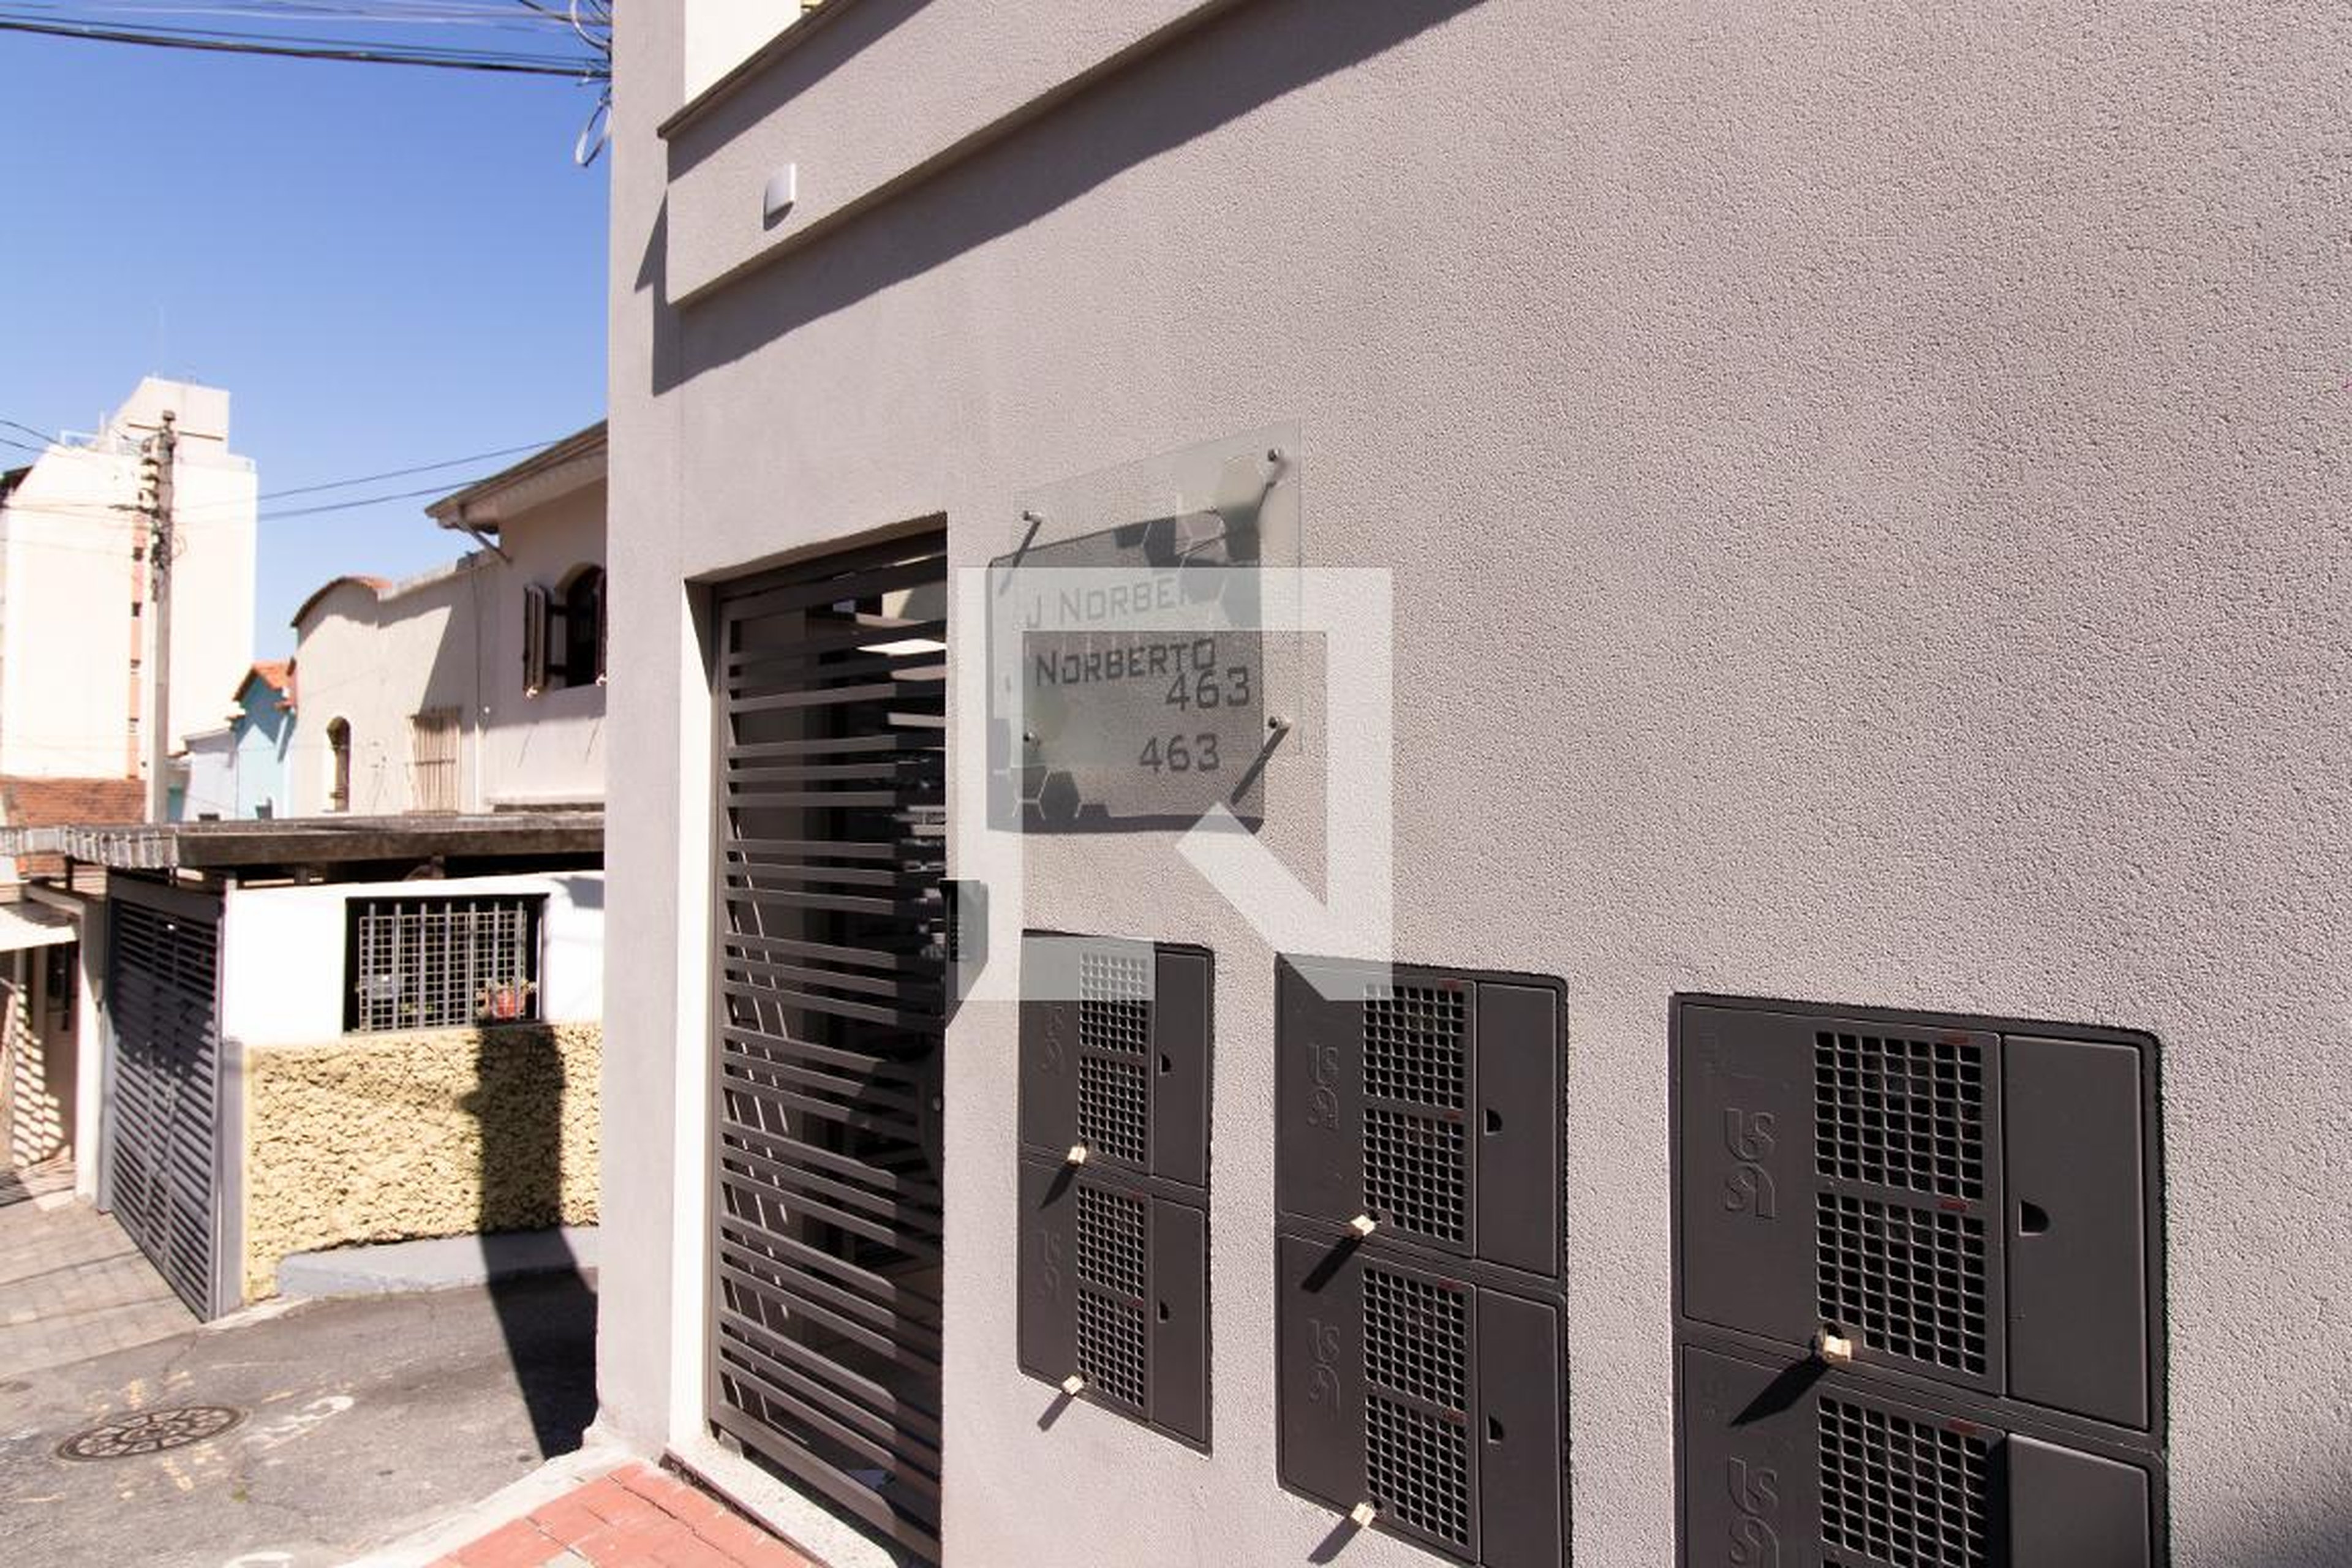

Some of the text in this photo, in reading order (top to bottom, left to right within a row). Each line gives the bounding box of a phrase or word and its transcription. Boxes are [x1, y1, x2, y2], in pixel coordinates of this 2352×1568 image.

[1036, 638, 1215, 686] NORBERTO
[1166, 667, 1250, 711] 463
[1139, 733, 1219, 772] 463
